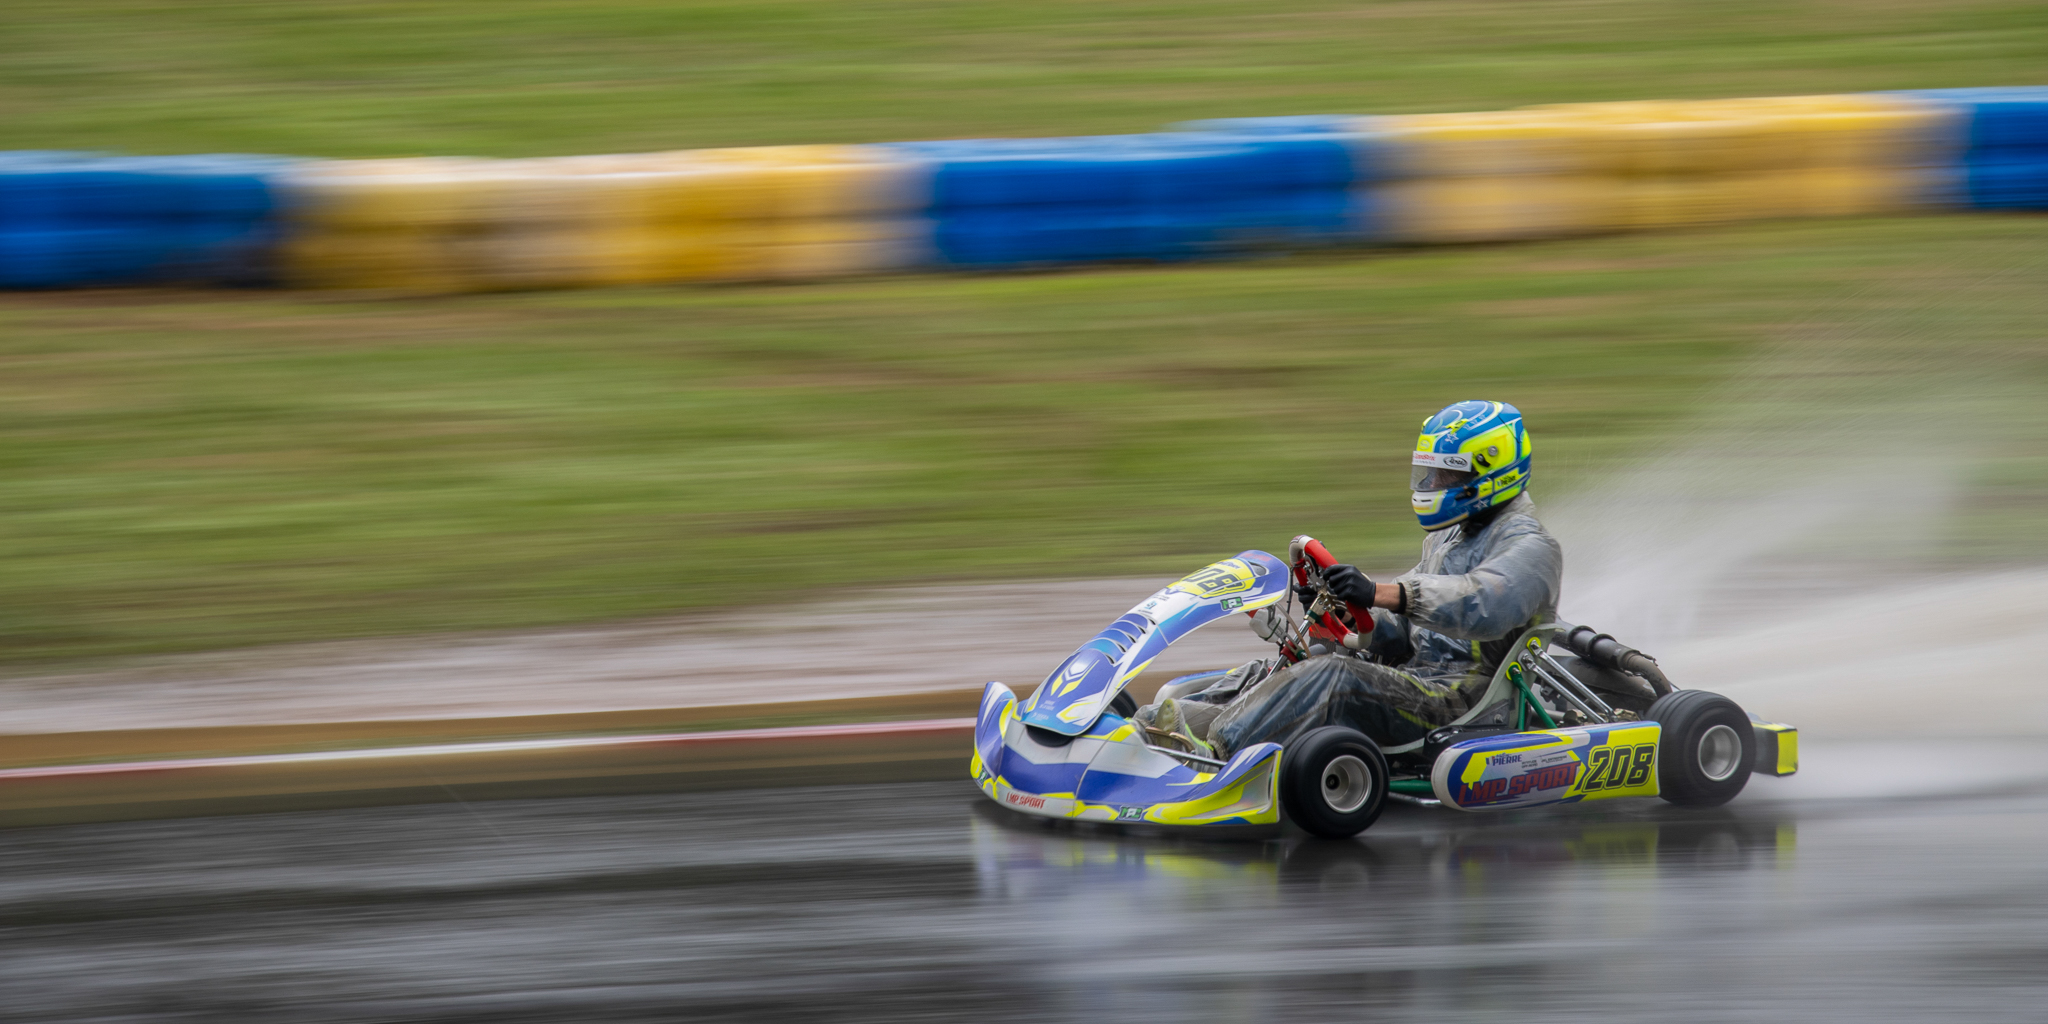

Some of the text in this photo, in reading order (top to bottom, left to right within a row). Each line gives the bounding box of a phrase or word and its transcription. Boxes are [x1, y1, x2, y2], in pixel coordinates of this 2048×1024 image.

[1181, 567, 1244, 594] 08
[1493, 754, 1522, 766] PIERRE
[1583, 743, 1657, 793] 208
[1457, 761, 1581, 805] LMP SPORT
[1019, 795, 1046, 809] SPORT
